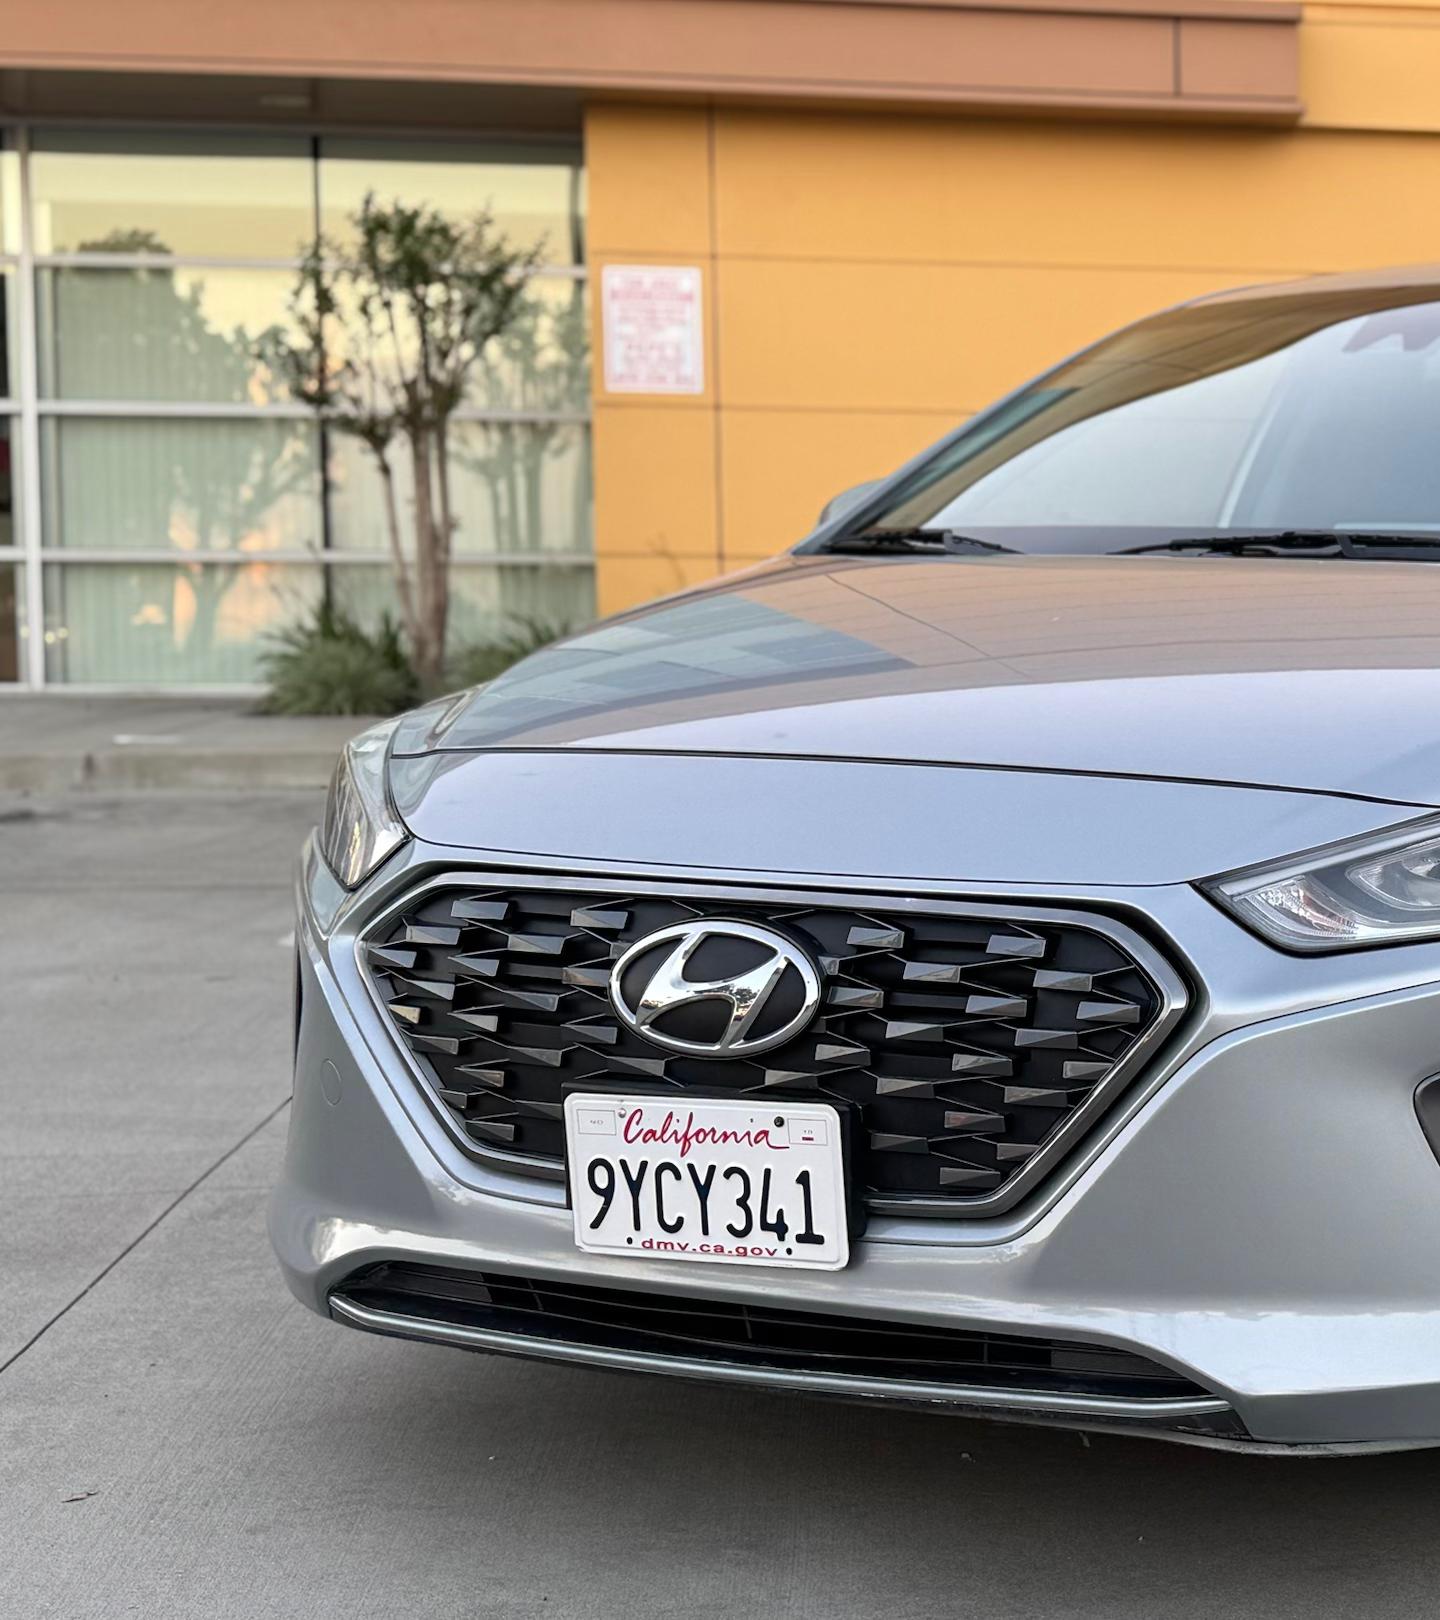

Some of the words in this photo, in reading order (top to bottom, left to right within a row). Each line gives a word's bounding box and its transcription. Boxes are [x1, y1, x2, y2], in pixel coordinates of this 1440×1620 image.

[623, 1108, 790, 1157] California
[587, 1157, 825, 1245] 9YCY341
[641, 1238, 778, 1257] dmv.ca.gov
